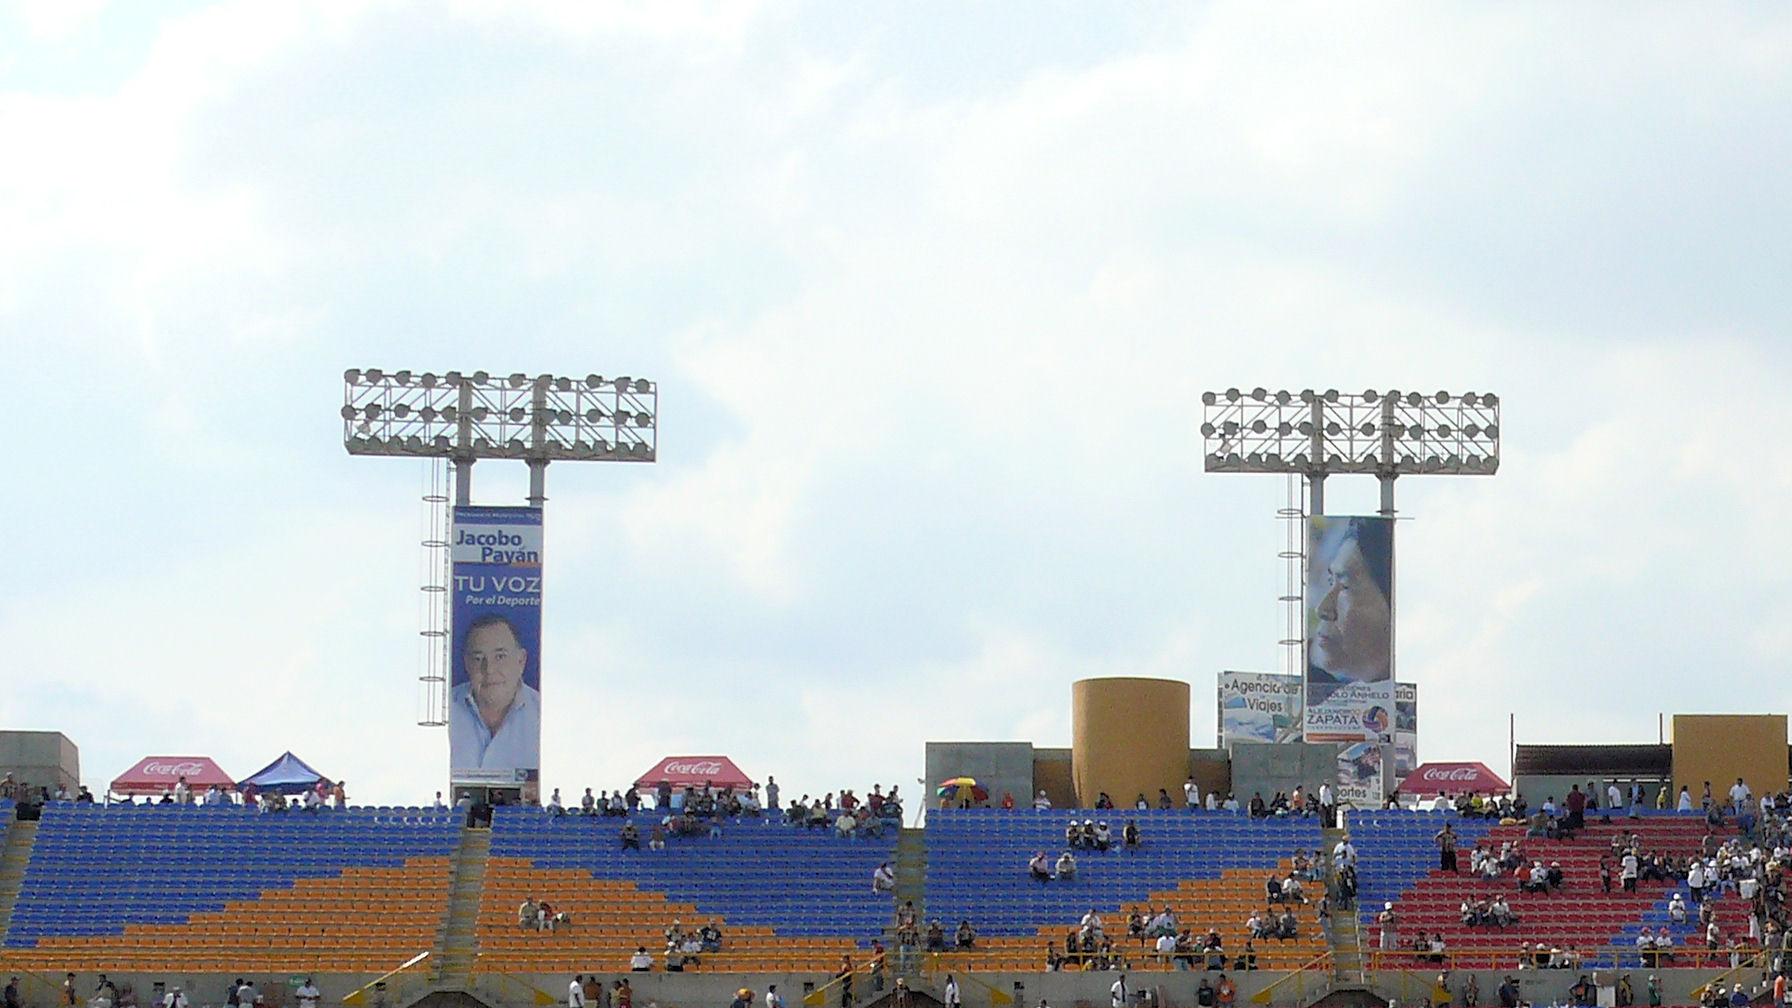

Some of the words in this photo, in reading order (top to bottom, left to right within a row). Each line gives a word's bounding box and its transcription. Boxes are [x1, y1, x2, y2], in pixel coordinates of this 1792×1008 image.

[456, 529, 522, 546] Jacobo
[453, 575, 485, 592] TU
[491, 576, 540, 592] VOZ
[1231, 678, 1280, 695] Agencia
[1247, 698, 1282, 713] Viajes
[1306, 714, 1359, 725] ZAPATA
